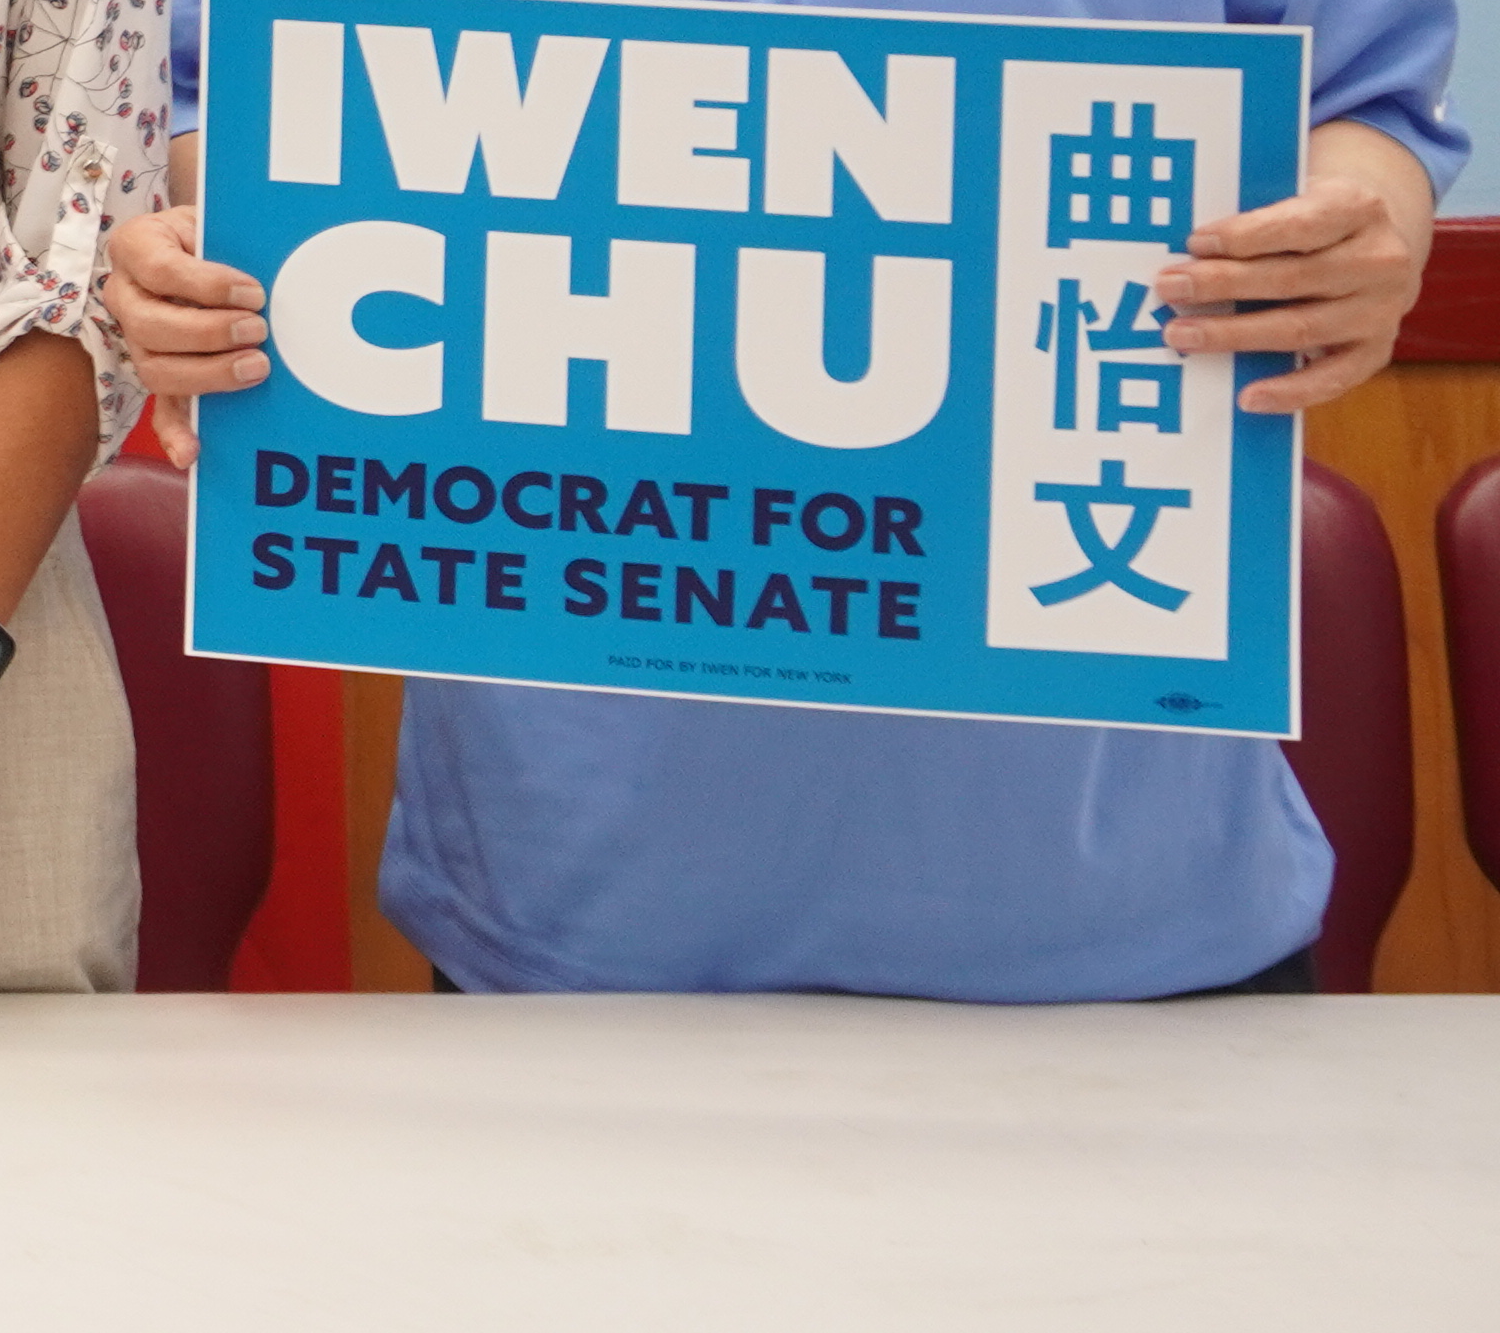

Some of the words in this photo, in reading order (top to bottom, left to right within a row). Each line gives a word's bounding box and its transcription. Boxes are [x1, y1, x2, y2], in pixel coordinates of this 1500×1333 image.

[268, 18, 957, 225] IWEN
[268, 219, 954, 451] CHU
[1029, 101, 1196, 613] 曲怡文
[253, 449, 730, 543] DEMOCRAT
[752, 488, 926, 558] FOR
[252, 531, 526, 613] STATE
[564, 556, 925, 641] SENATE
[608, 655, 642, 669] PAID
[646, 658, 673, 671] FOR
[679, 661, 696, 673] BY
[702, 662, 739, 676] IWEN
[743, 664, 771, 678] FOR
[778, 667, 809, 681] NEW
[813, 670, 852, 684] YORK
